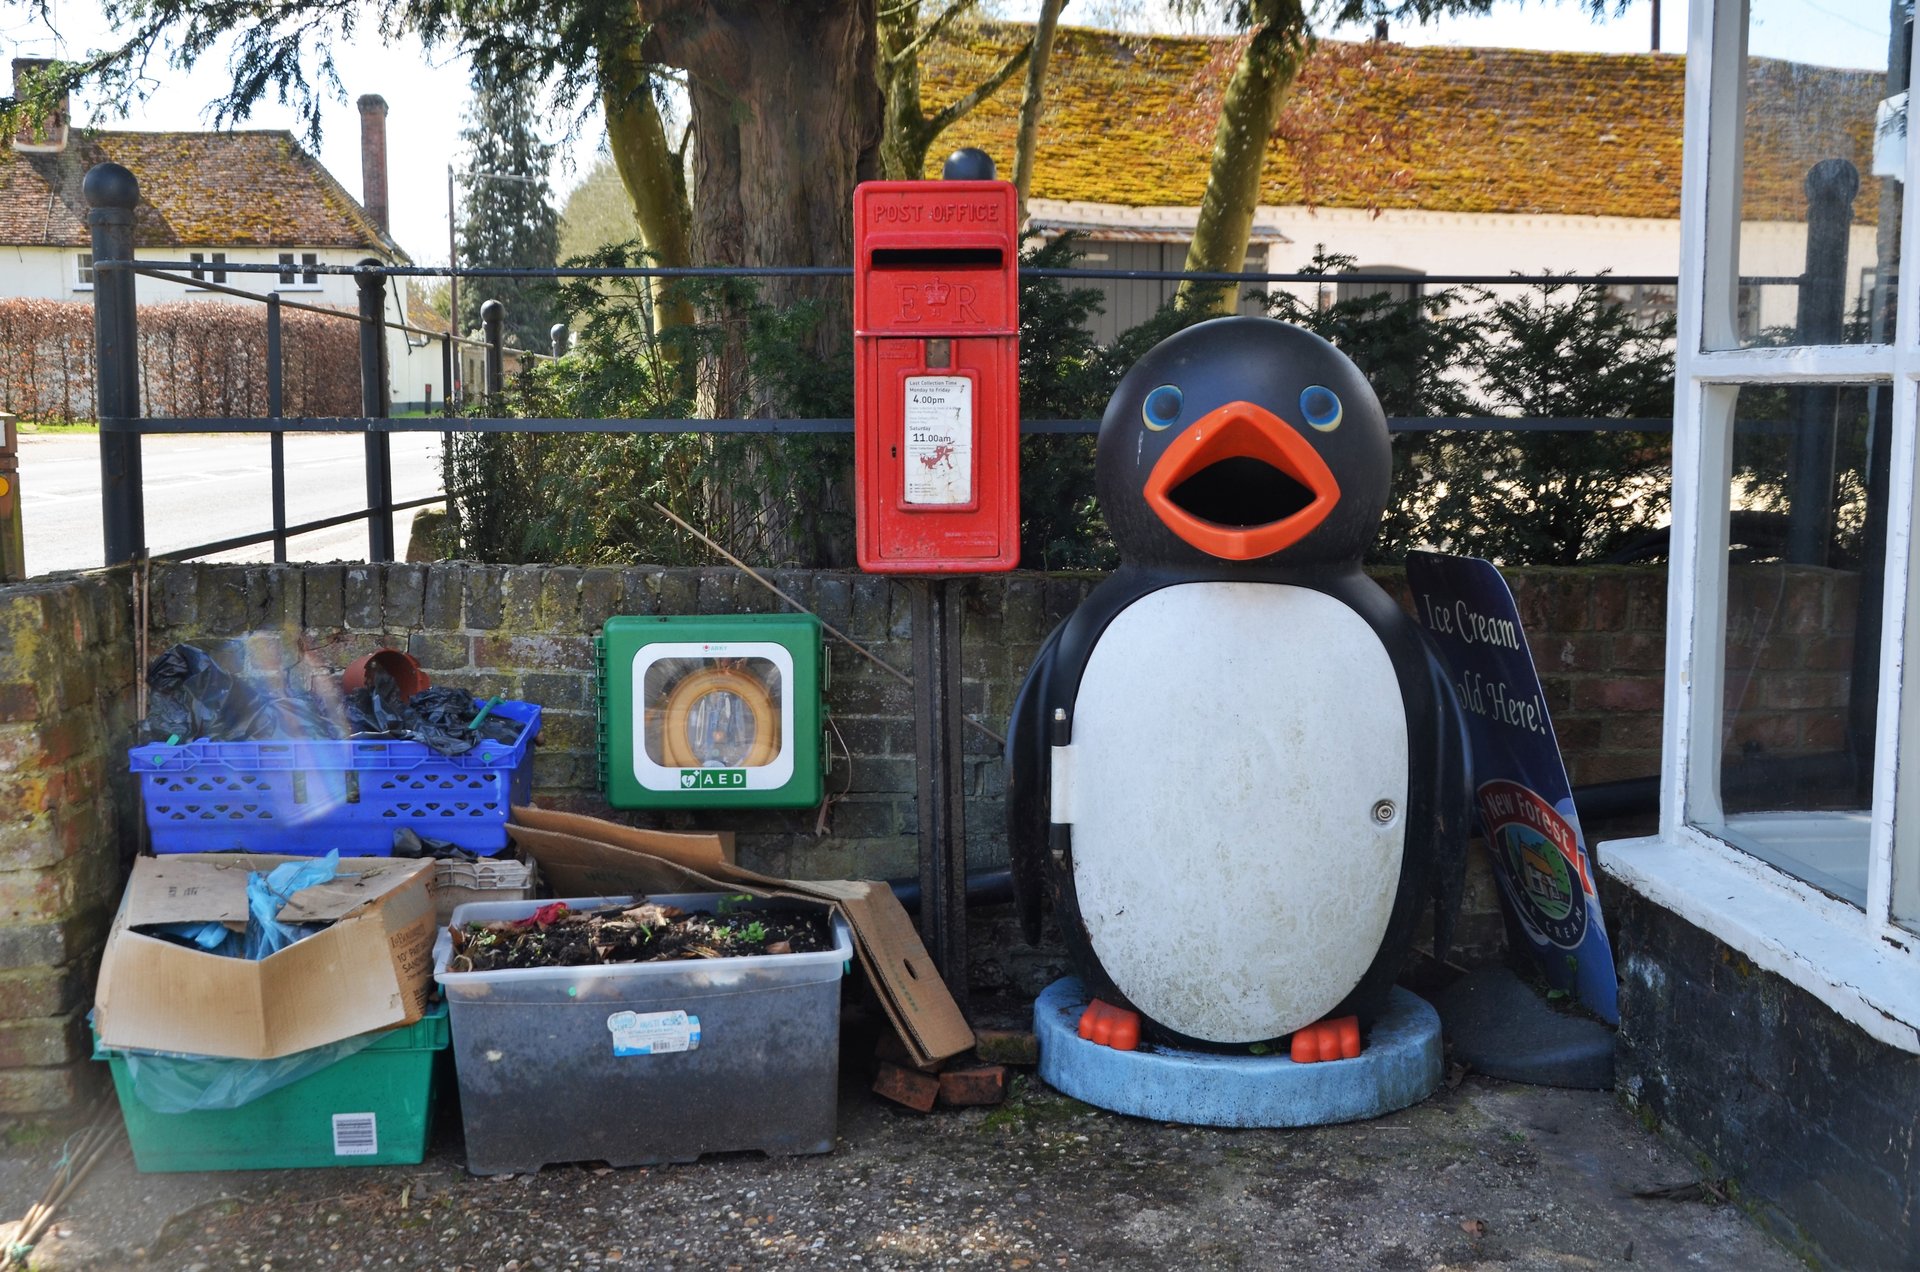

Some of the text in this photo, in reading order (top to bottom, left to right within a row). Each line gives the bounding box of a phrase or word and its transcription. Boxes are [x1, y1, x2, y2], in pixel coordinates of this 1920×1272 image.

[874, 202, 999, 223] POST OFFICE
[913, 394, 945, 405] 4.00pm
[912, 433, 951, 442] 11.00am
[1424, 594, 1519, 650] Ice Cream
[1457, 669, 1546, 735] old Here!
[703, 773, 743, 784] AED
[1485, 790, 1570, 852] New Forest
[1545, 906, 1583, 938] CREAM
